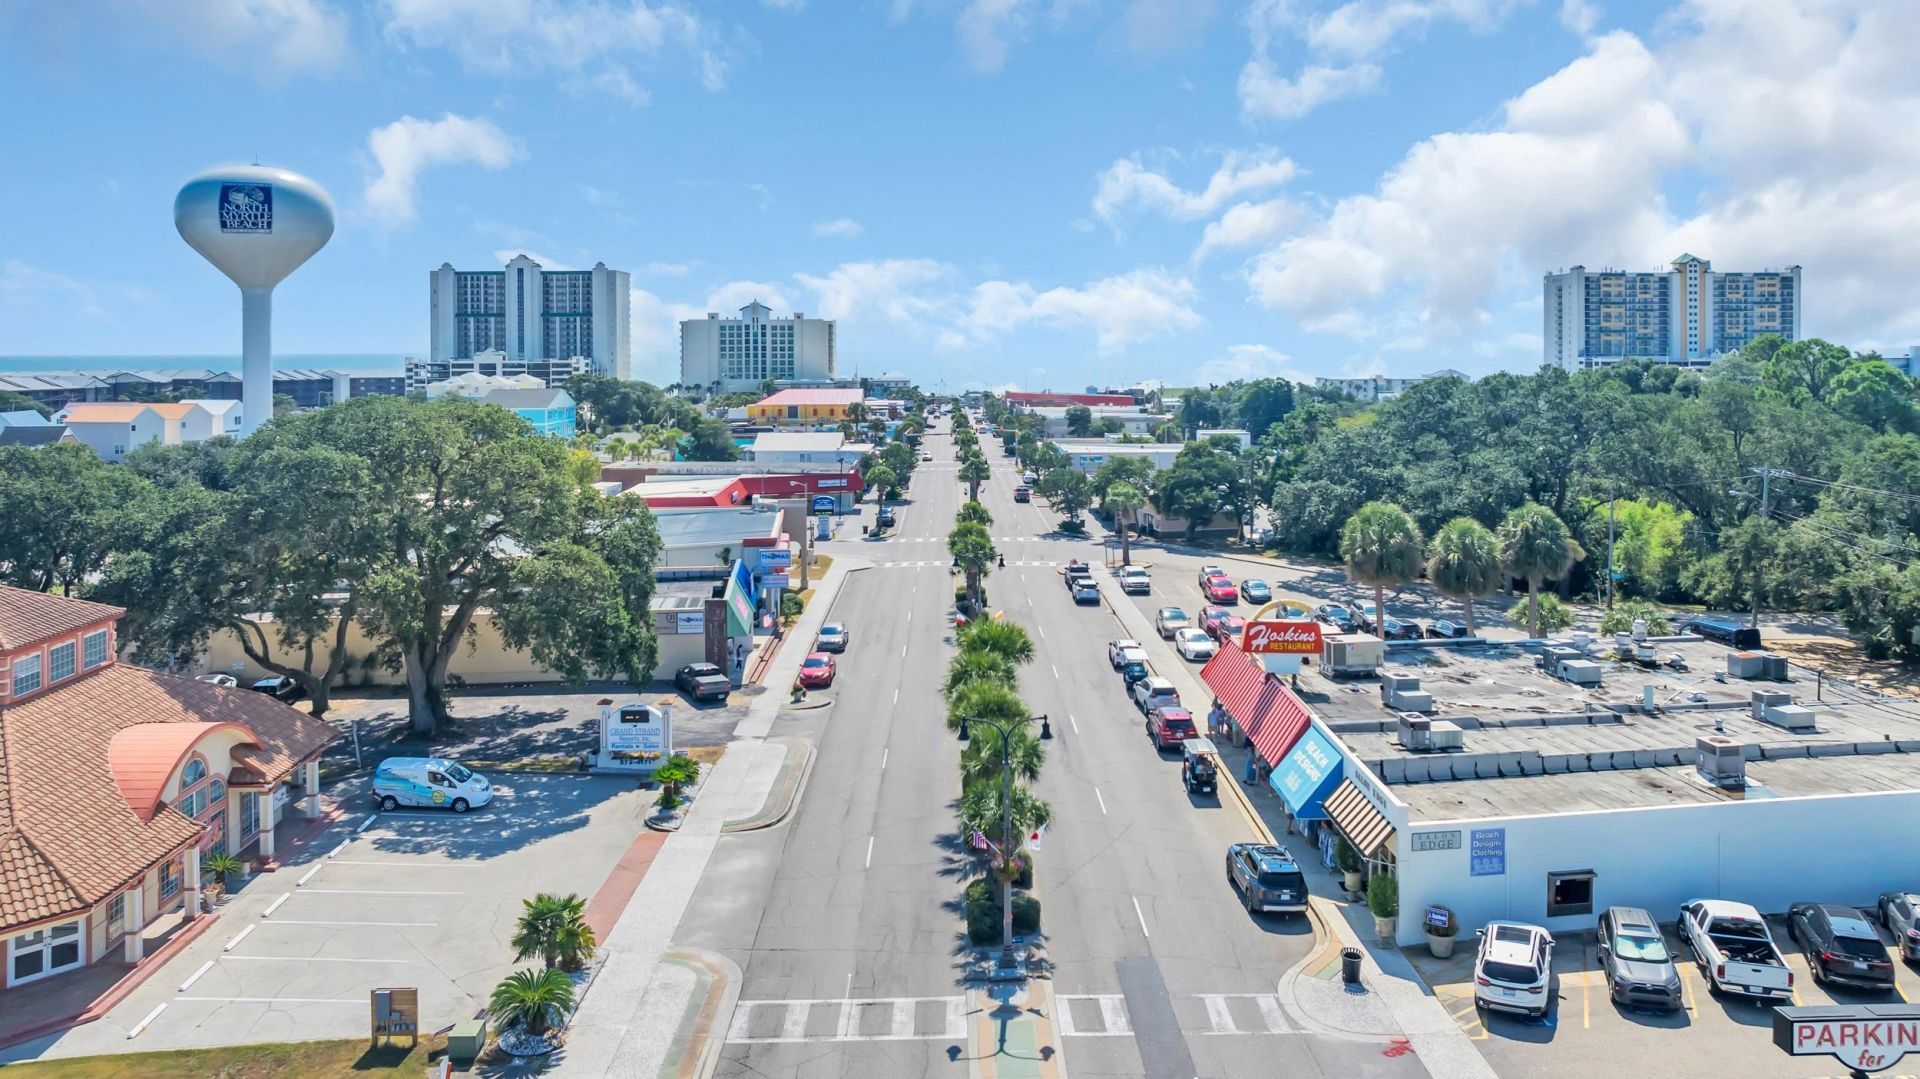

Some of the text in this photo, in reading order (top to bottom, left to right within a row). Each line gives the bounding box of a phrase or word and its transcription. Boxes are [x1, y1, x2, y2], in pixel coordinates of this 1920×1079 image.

[224, 203, 268, 212] NORTH
[222, 211, 271, 221] MYRTLE
[226, 220, 268, 229] BEACH
[1249, 625, 1317, 651] Hoskins
[1269, 642, 1316, 651] RESTAURANT
[1305, 740, 1329, 768] BEACH
[1293, 750, 1322, 782] DESIGNS
[1475, 831, 1500, 839] Beach
[1420, 840, 1454, 850] EDGE
[1472, 849, 1503, 857] Clothing
[1858, 1049, 1885, 1067] for
